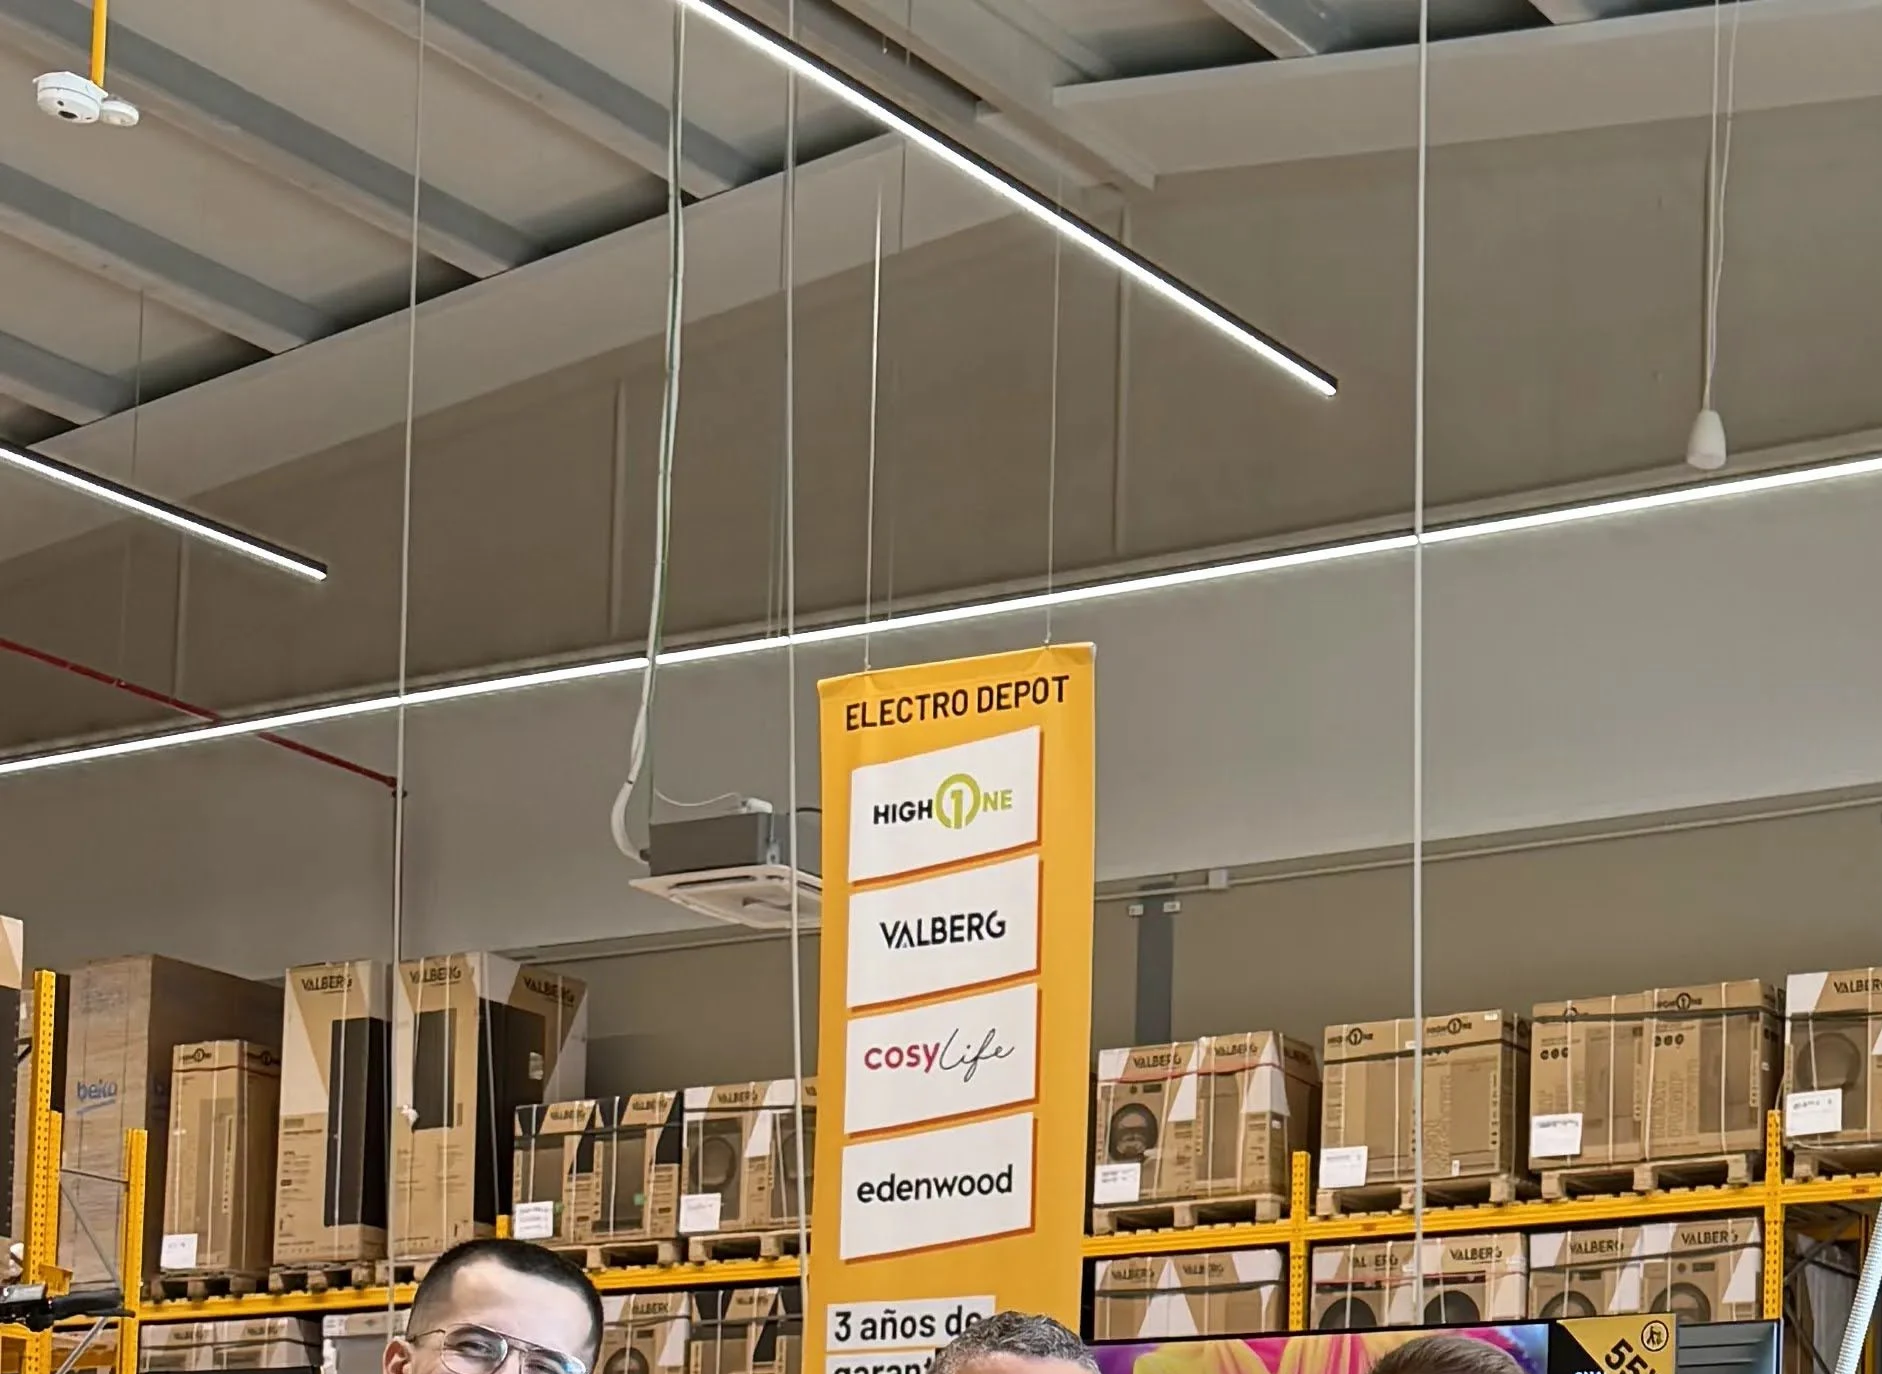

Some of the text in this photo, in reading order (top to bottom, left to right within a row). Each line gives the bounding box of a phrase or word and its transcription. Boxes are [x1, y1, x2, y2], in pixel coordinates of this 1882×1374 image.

[846, 675, 1070, 731] ELECTRO DEPOT
[879, 910, 1006, 949] VALBERG
[856, 1163, 1013, 1203] edenwood
[834, 1311, 852, 1342] 3
[860, 1308, 936, 1341] años
